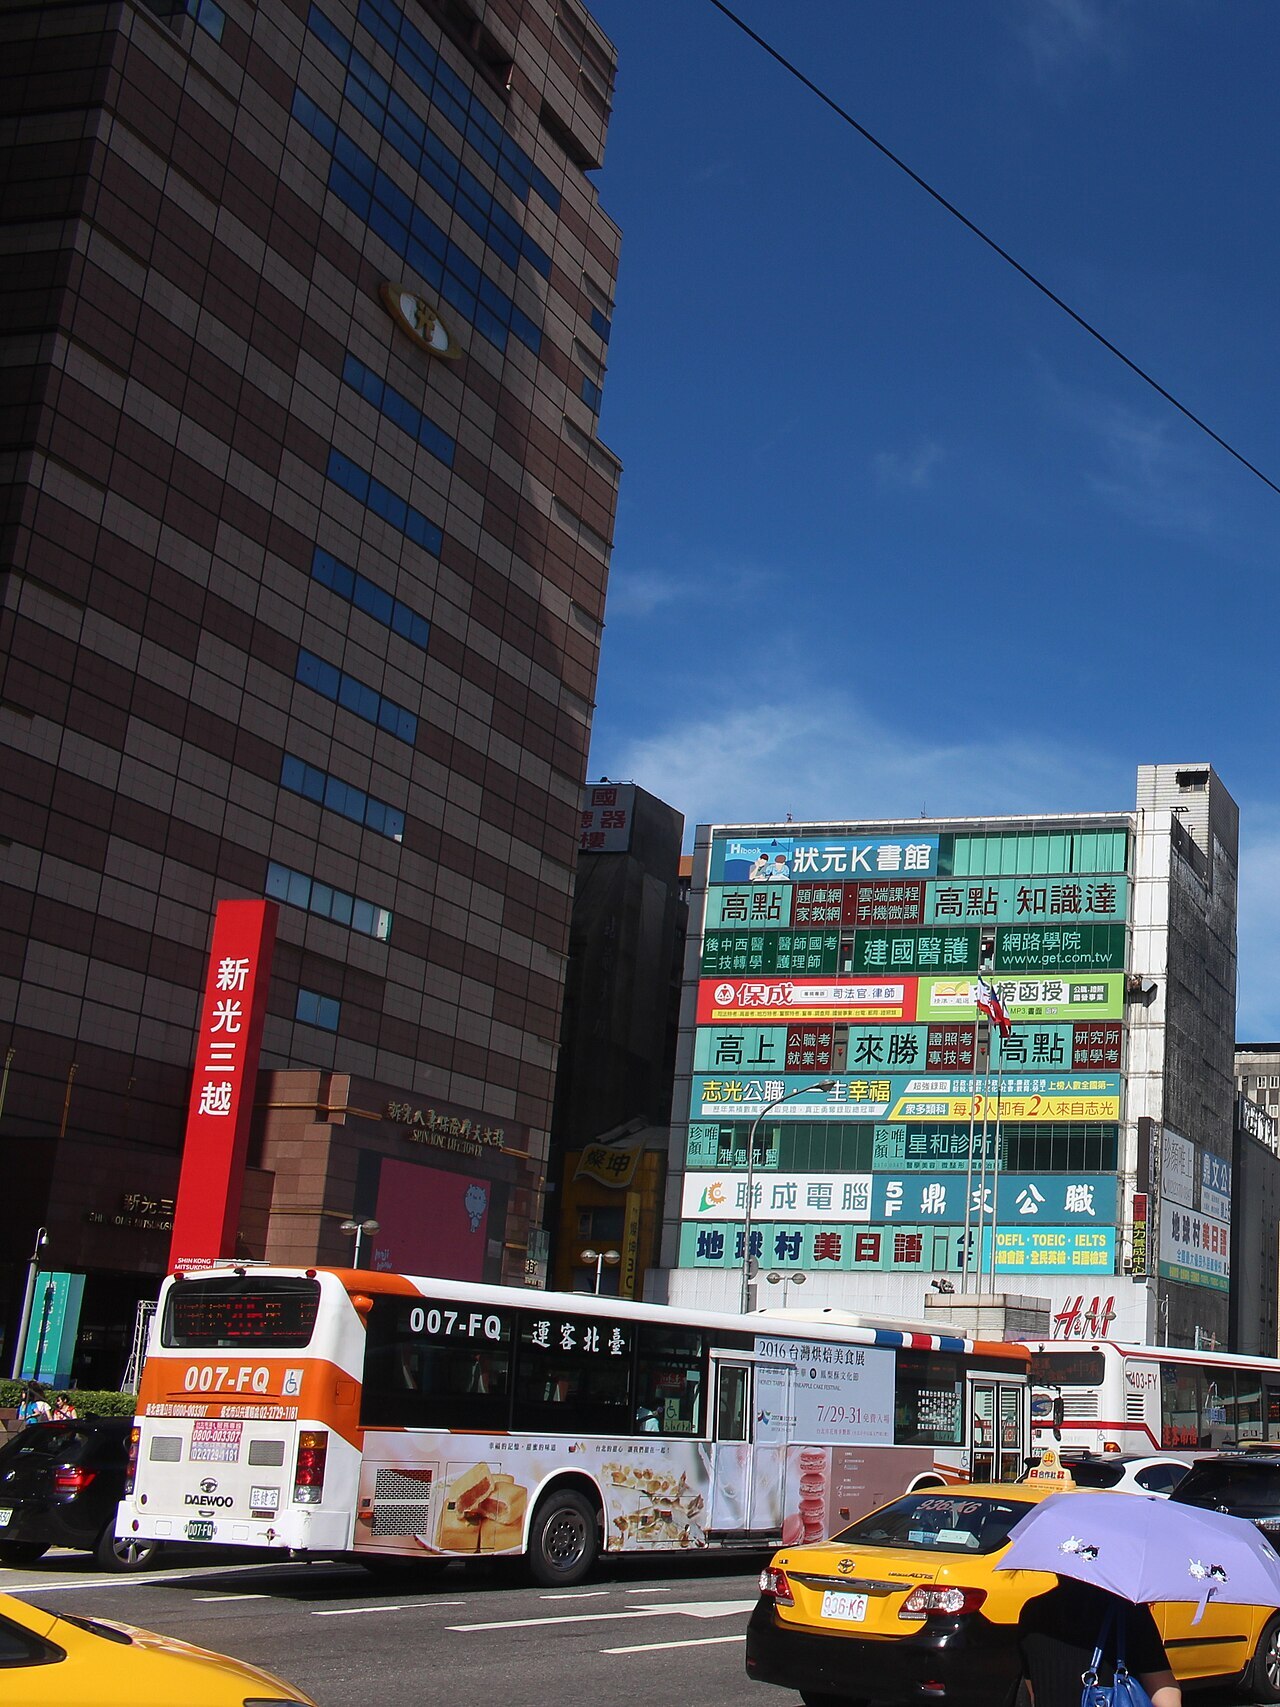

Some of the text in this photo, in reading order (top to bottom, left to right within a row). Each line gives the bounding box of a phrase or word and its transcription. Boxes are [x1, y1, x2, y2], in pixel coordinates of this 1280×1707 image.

[793, 843, 932, 873] 狀元K書館
[721, 891, 782, 922] 高點
[863, 936, 969, 967] 建國醫護
[1001, 931, 1082, 952] 網路學院
[1001, 952, 1113, 966] www.get.com.tw
[736, 981, 794, 1007] 保成
[197, 956, 249, 1117] 新光三越
[788, 1033, 832, 1047] 公職考
[929, 1032, 974, 1047] 證照考
[999, 1032, 1066, 1065] 高點
[1074, 1029, 1120, 1045] 研究所
[715, 1034, 776, 1066] 高上
[787, 1051, 831, 1066] 就業考
[853, 1033, 919, 1066] 來勝
[928, 1050, 973, 1065] 專技考
[1073, 1048, 1119, 1065] 轉學考
[908, 1133, 992, 1155] 星和診所
[735, 1181, 869, 1211] 聯成電腦
[919, 1182, 1096, 1217] 鼎文公職
[696, 1230, 923, 1264] 地球村美日語
[1032, 1234, 1066, 1246] TOEIC
[1074, 1234, 1106, 1247] IELTS
[409, 1306, 502, 1342] 007-FQ
[1053, 1295, 1115, 1338] H&M
[759, 1340, 786, 1359] 2016
[184, 1365, 271, 1395] 007-FQ
[817, 1405, 861, 1425] 7/29-31
[184, 1494, 234, 1508] DAEWOO
[188, 1523, 213, 1538] 007-FQ
[823, 1594, 866, 1619] 936-K6
